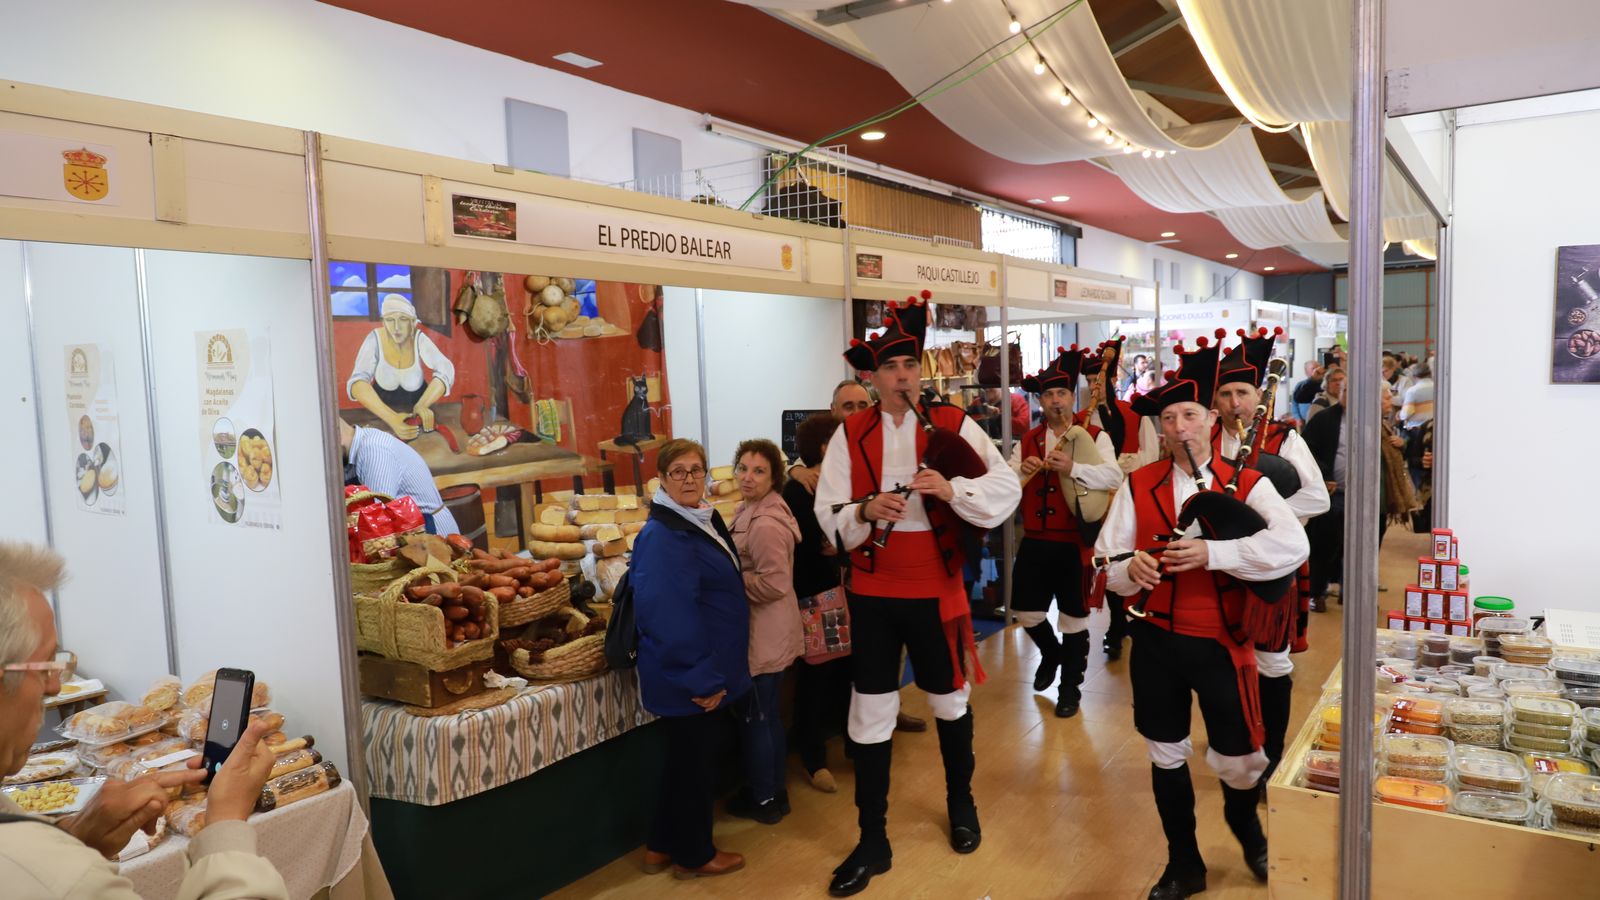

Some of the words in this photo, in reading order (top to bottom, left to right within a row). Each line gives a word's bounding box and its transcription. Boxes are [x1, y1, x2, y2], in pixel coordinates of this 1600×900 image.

[598, 224, 616, 247] EL
[621, 227, 676, 253] PREDIO
[681, 235, 731, 260] BALEAR
[917, 265, 939, 281] PAQUI
[941, 267, 980, 284] CASTILLEJO
